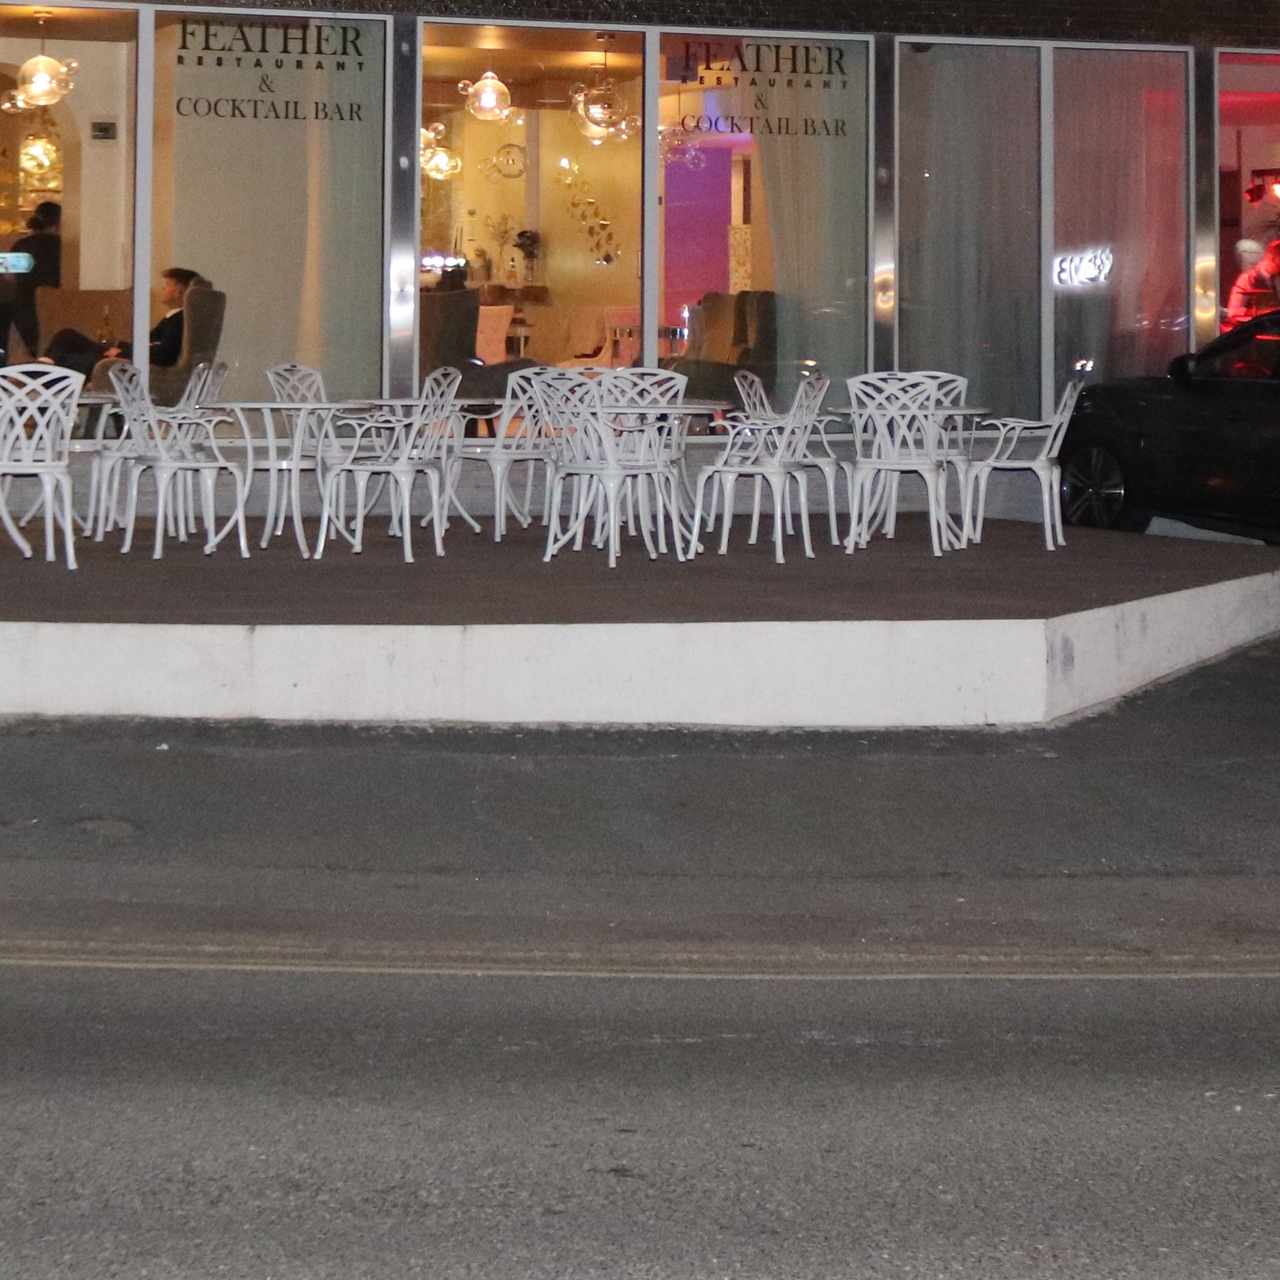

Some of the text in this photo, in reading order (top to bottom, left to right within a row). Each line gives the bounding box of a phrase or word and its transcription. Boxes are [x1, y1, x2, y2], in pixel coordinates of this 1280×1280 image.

[178, 19, 363, 56] FEATHER
[177, 55, 364, 71] RESTAURANT
[682, 41, 848, 75] FEATHER
[259, 74, 275, 93] &
[681, 75, 848, 89] RESTAURANT
[176, 96, 363, 121] COCKTAIL BAR
[754, 94, 769, 110] &
[681, 114, 848, 136] COCKTAIL BAR
